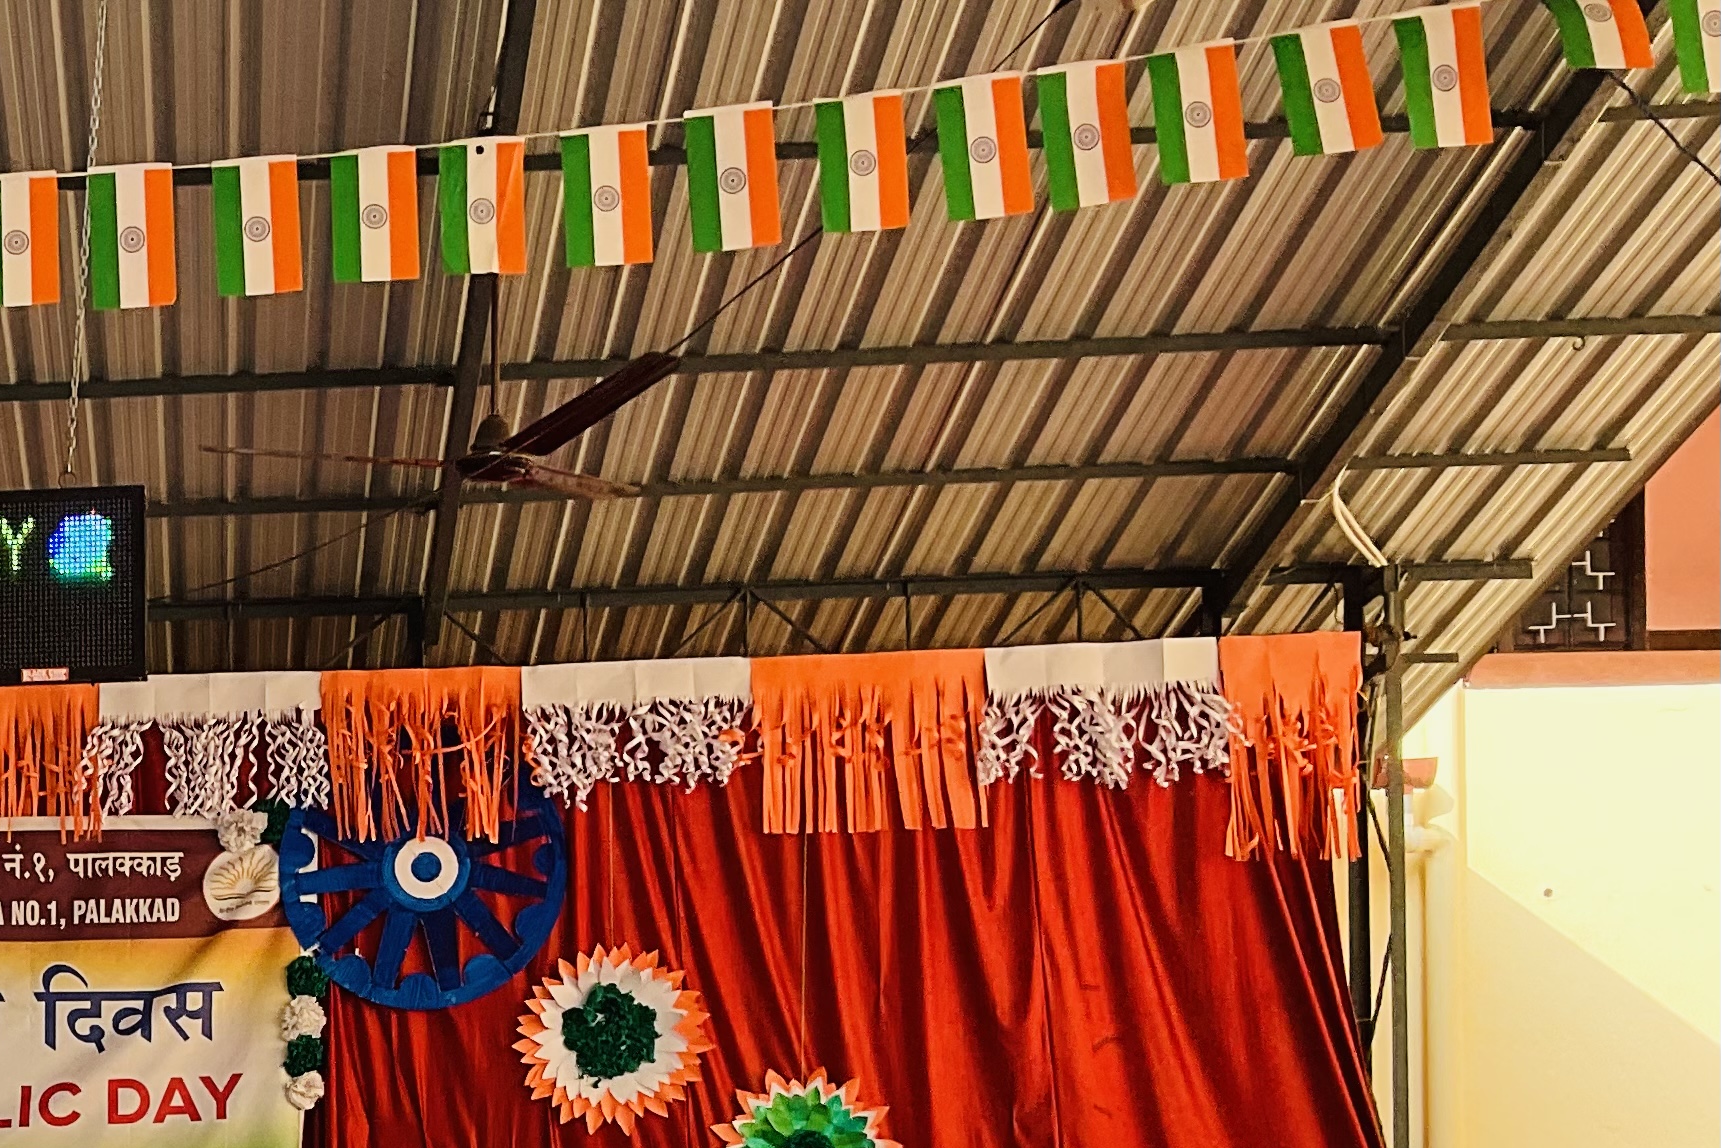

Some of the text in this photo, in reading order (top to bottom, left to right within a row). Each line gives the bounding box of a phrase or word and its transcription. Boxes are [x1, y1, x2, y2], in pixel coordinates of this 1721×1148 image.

[66, 851, 184, 882] पालक्काड़
[11, 900, 66, 930] NO.1,
[73, 897, 180, 925] PALAKKAD
[34, 964, 224, 1054] दिवस
[107, 1073, 243, 1125] DAY
